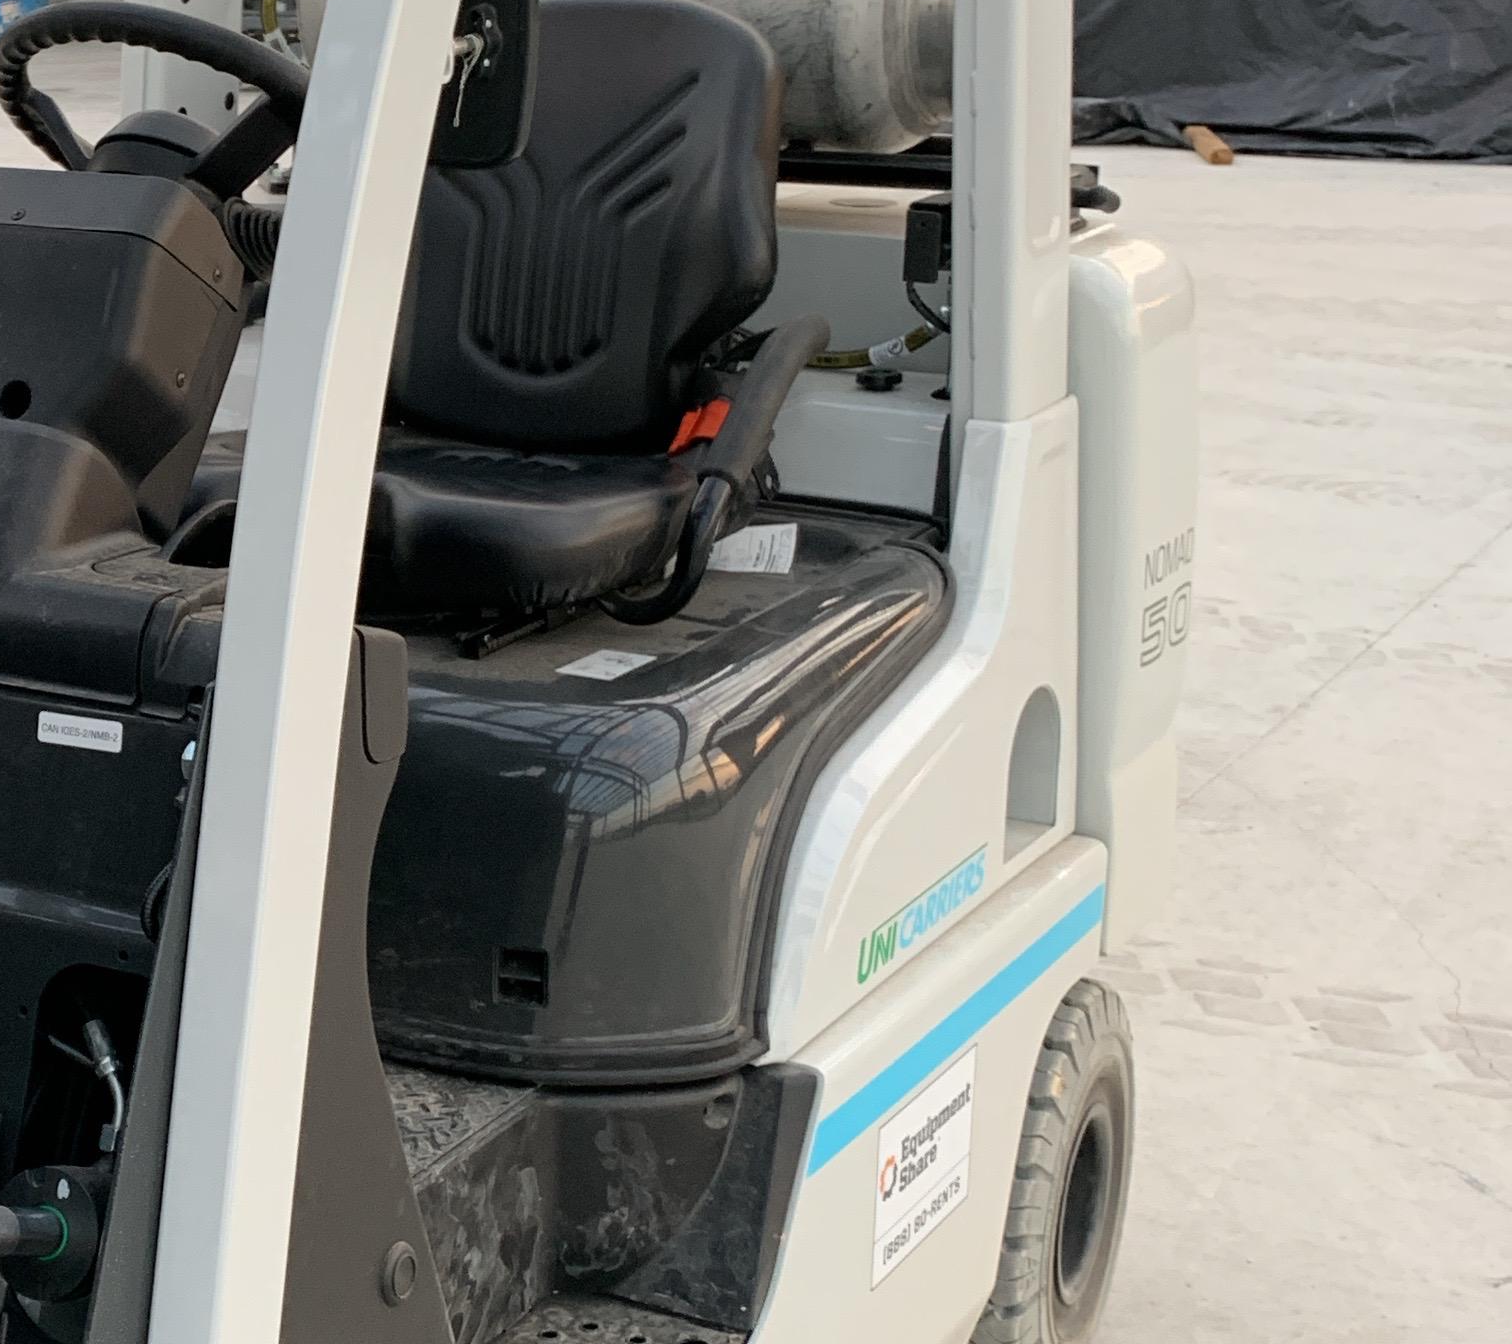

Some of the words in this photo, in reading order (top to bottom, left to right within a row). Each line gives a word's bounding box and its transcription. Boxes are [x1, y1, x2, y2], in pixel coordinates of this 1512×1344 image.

[1140, 580, 1192, 668] 50
[857, 844, 987, 985] UNICARRIERS
[900, 1082, 972, 1164] Equipment
[898, 1142, 939, 1193] Share
